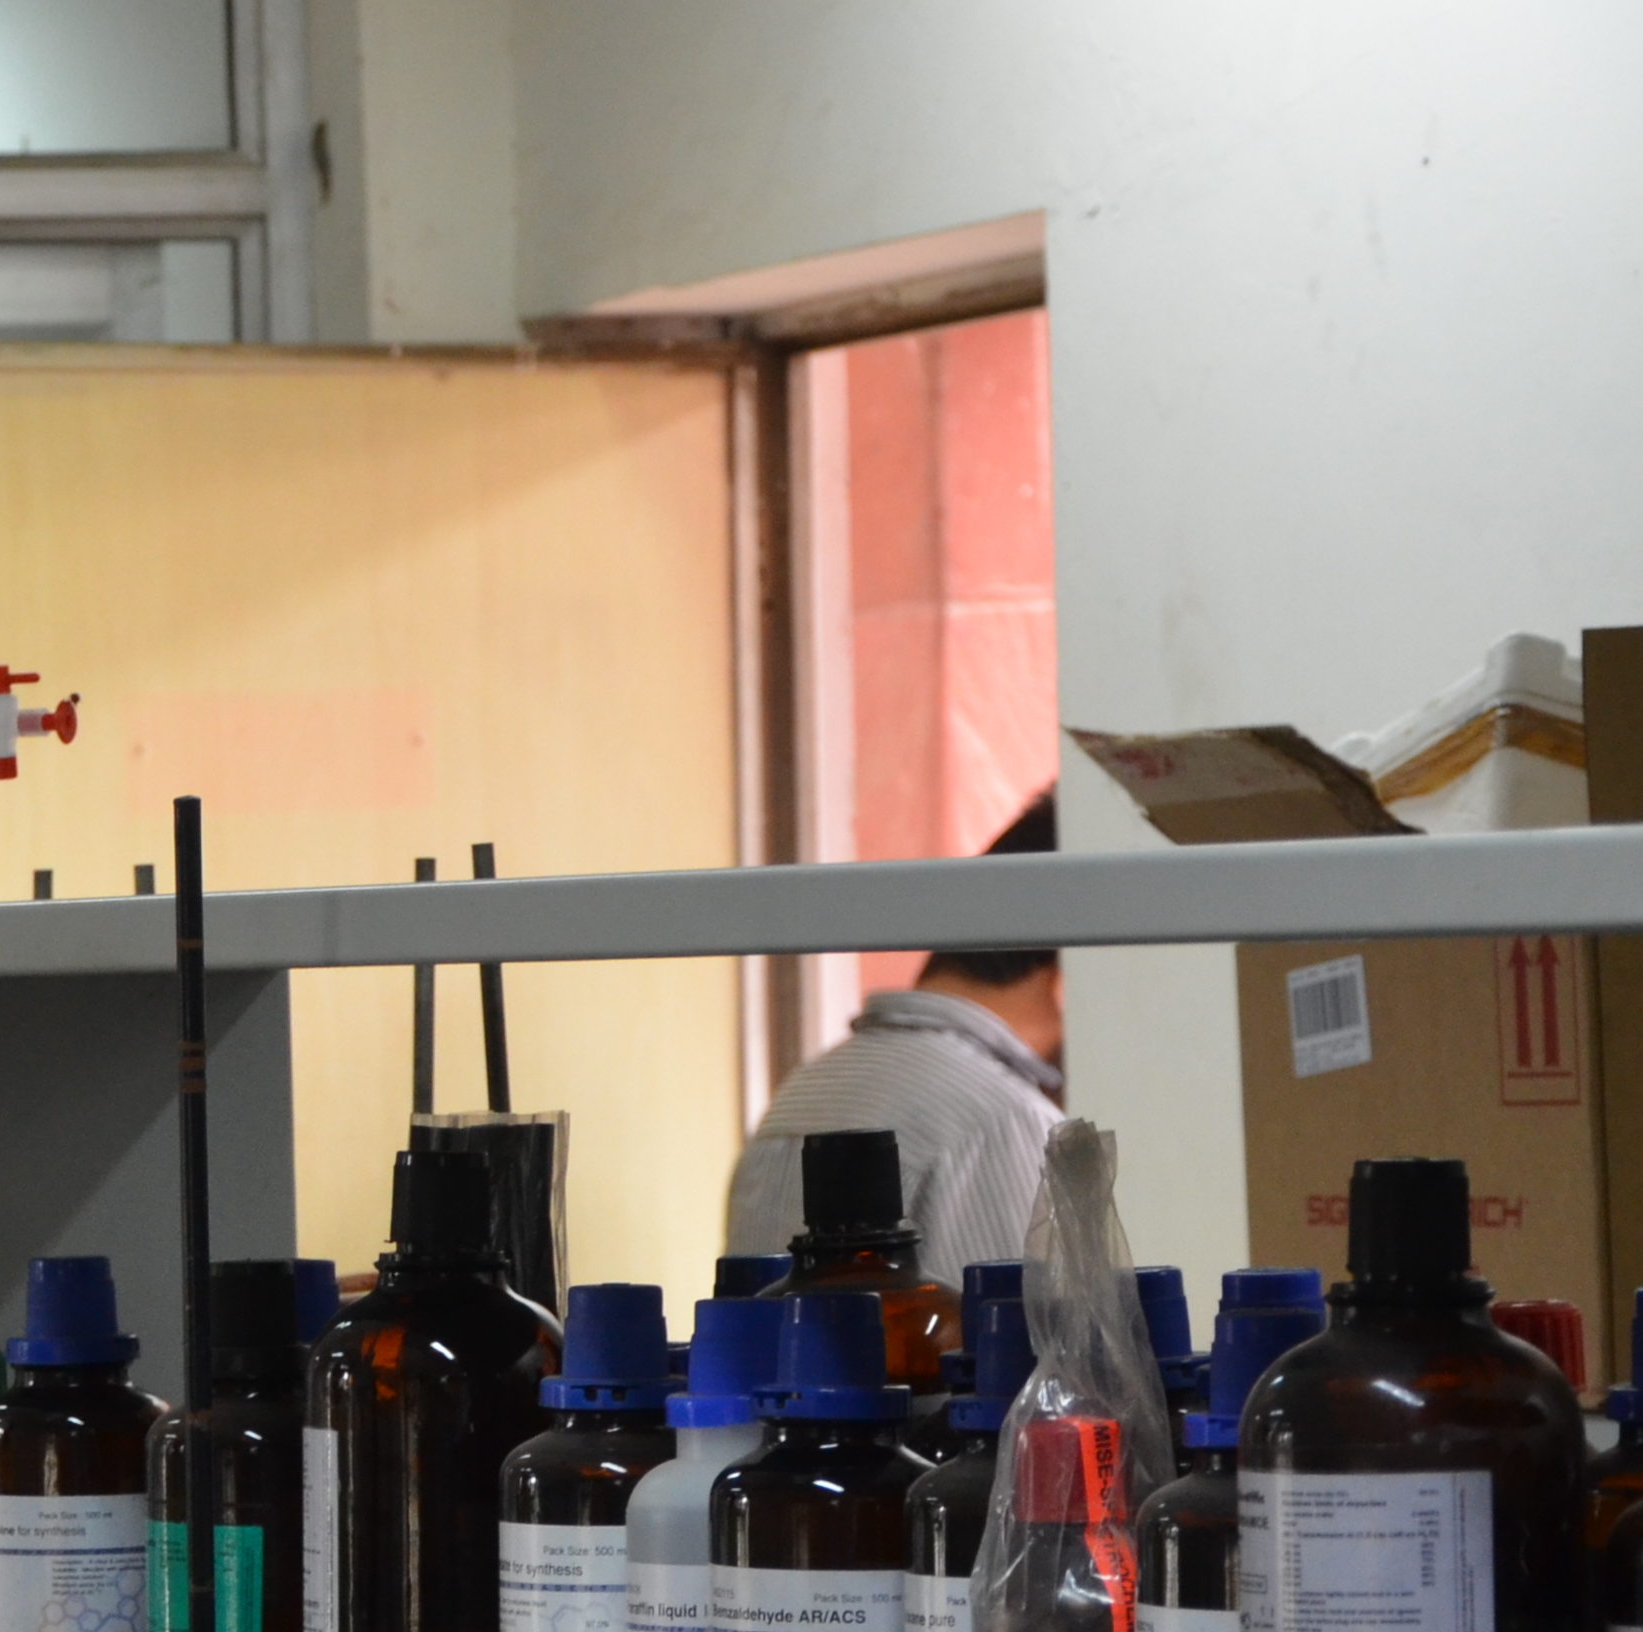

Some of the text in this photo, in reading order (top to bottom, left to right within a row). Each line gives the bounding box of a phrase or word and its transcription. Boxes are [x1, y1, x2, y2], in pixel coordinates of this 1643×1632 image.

[17, 1525, 31, 1536] for
[34, 1527, 86, 1539] synthesis
[543, 1546, 564, 1555] Pack
[594, 1546, 615, 1556] 500
[512, 1560, 524, 1574] for
[526, 1563, 583, 1578] synthesis
[814, 1593, 837, 1603] Pack
[841, 1594, 863, 1603] Size
[872, 1594, 888, 1603] 500
[658, 1603, 697, 1620] liquid
[713, 1604, 867, 1625] Benzaldehyde AR/ACS
[929, 1614, 956, 1629] pure
